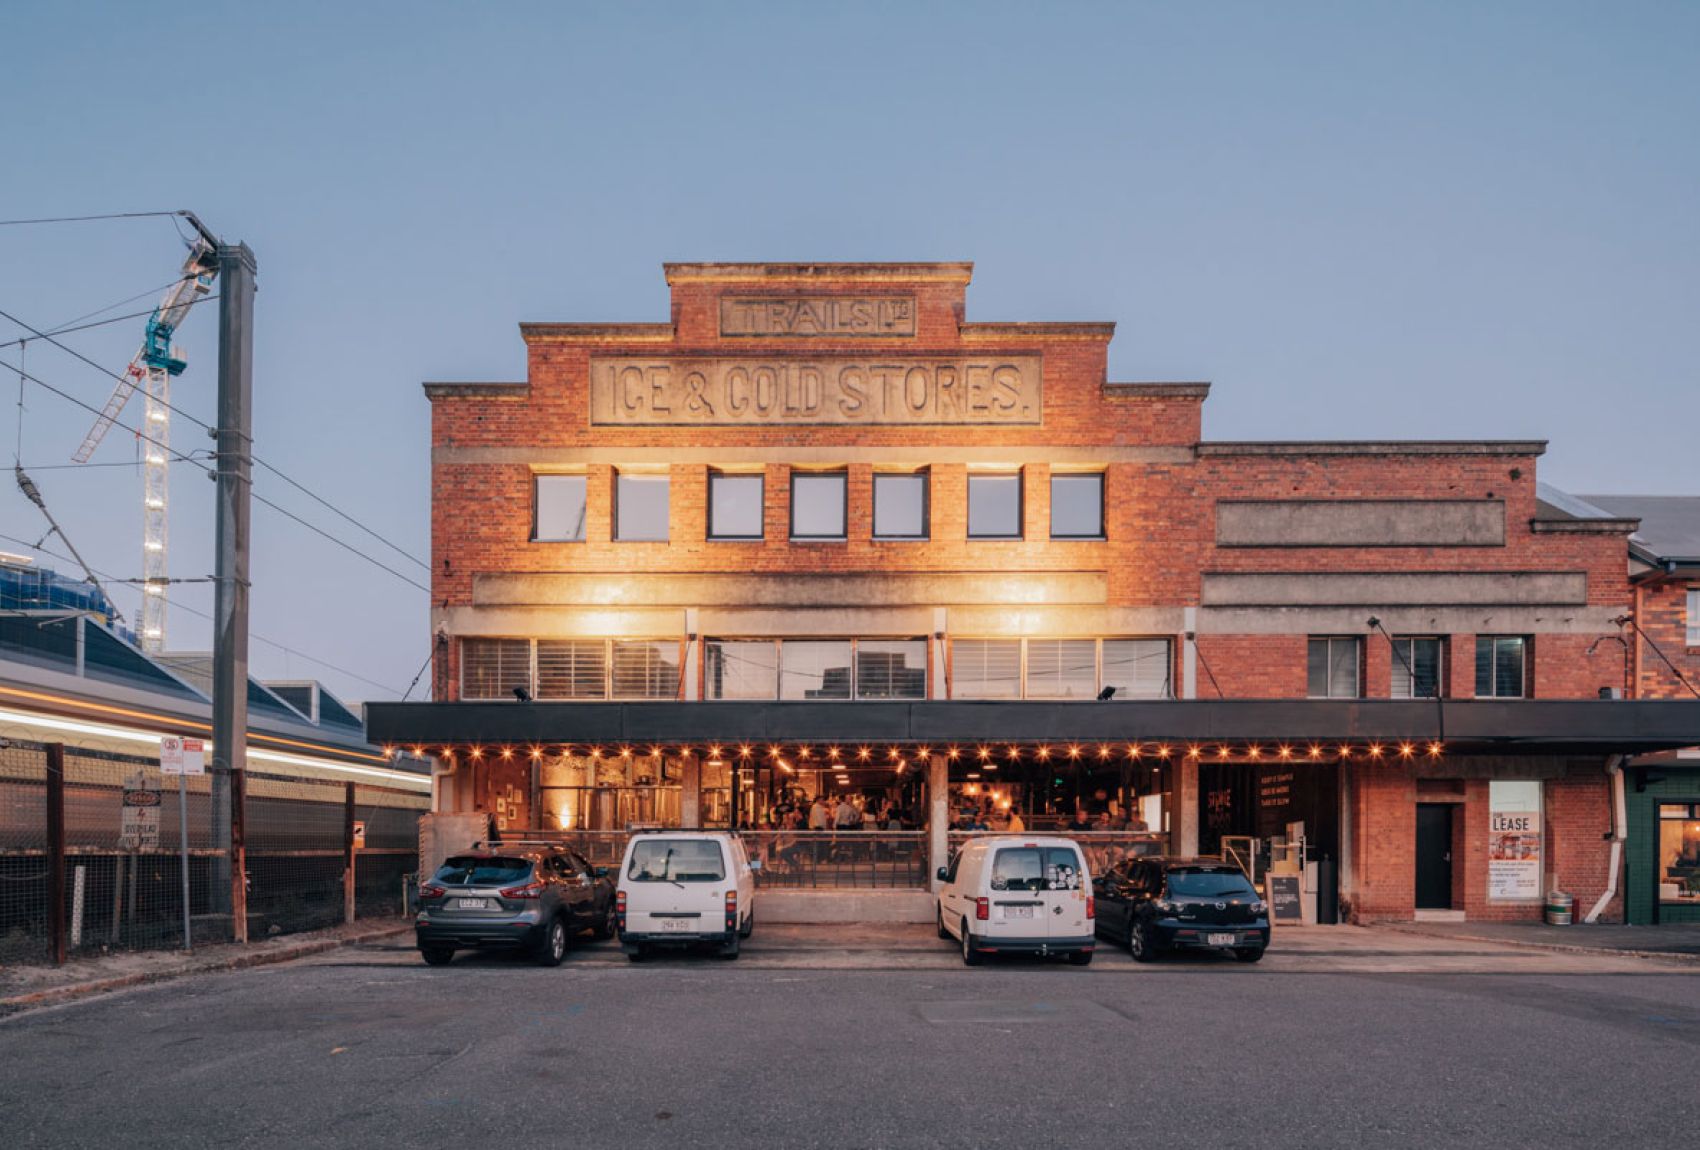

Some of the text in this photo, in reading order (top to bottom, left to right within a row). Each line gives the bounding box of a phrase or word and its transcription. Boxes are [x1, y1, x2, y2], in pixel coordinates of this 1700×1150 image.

[734, 301, 874, 333] TRAILS
[609, 365, 1030, 417] ICE & COLD STORES.
[1493, 818, 1529, 831] LEASE
